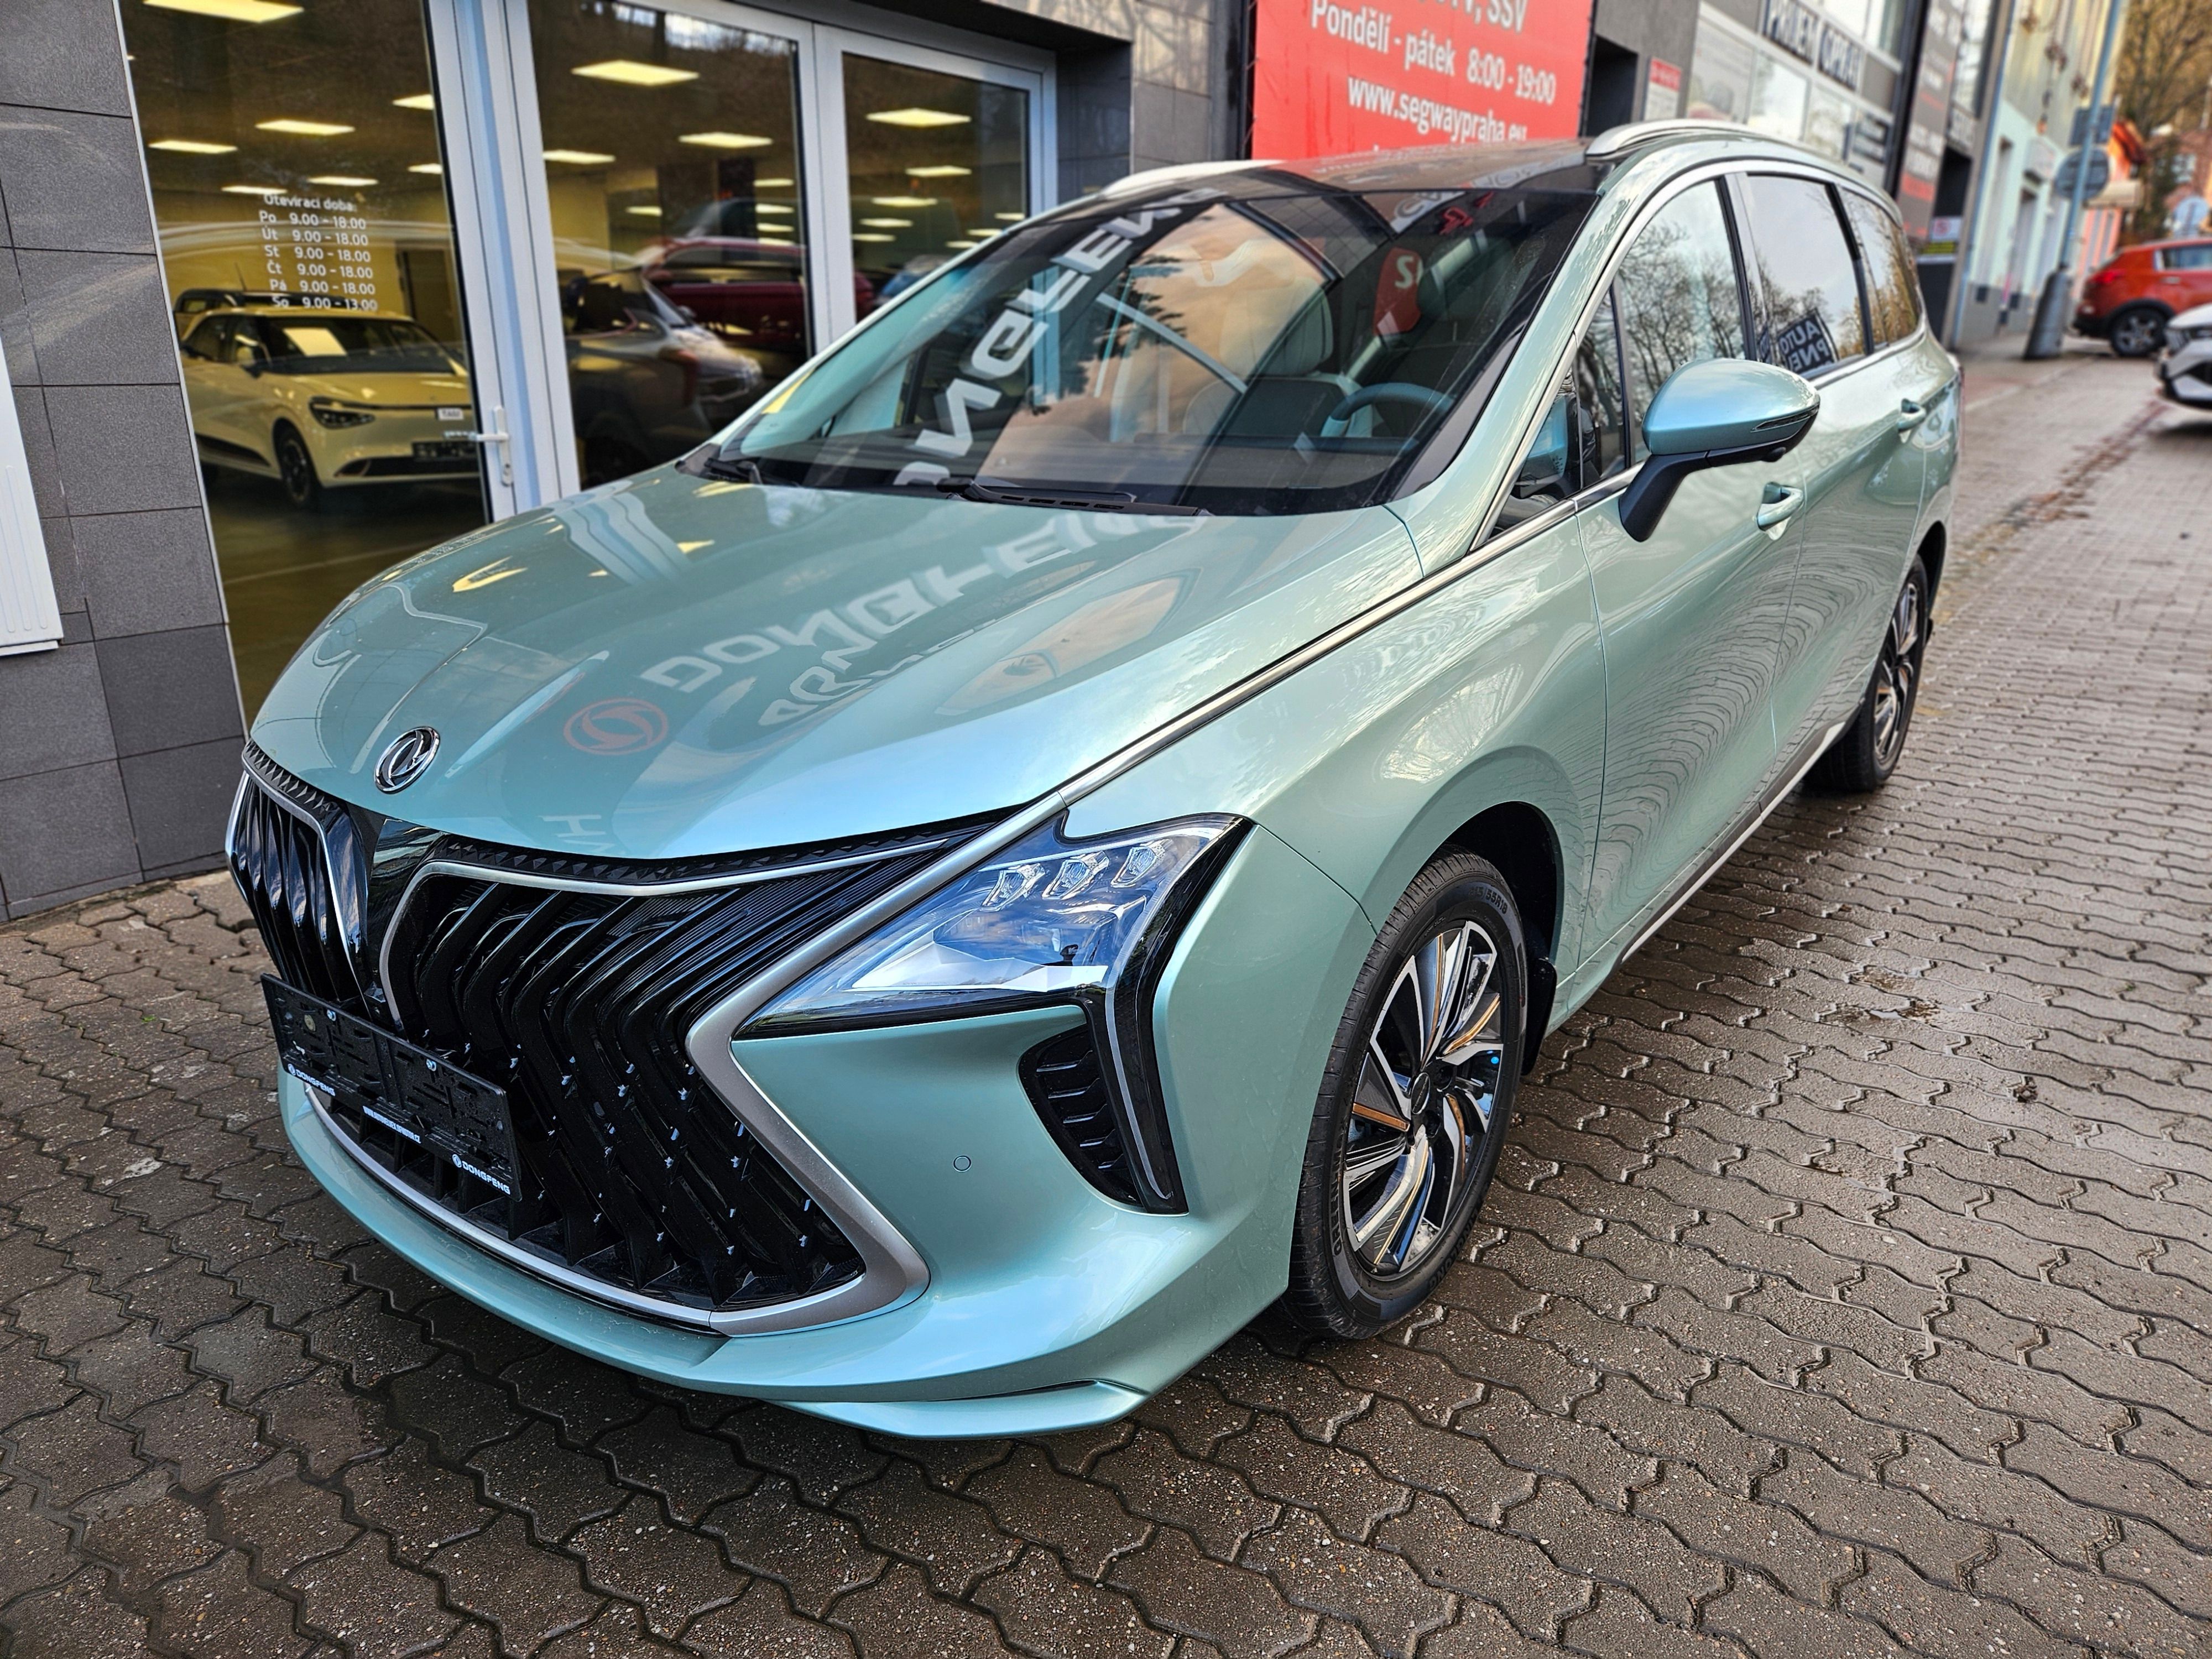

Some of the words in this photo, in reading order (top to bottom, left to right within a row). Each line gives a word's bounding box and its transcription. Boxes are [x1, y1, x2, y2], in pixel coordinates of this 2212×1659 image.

[1311, 0, 1392, 54] Pondělí
[1405, 29, 1455, 76] pátek
[1467, 47, 1505, 90] 8:00
[1515, 64, 1556, 106] 19:00
[1348, 76, 1527, 143] www.segwayprahaeu
[259, 210, 276, 222] Po
[289, 212, 319, 226] 9.00
[333, 216, 366, 230] 18.00
[262, 225, 278, 240] Út
[293, 229, 321, 242] 9.00
[335, 233, 368, 246] 18.00
[264, 245, 280, 258] St
[295, 247, 324, 259] 9.00
[337, 249, 371, 262] 18.00
[267, 260, 283, 274] Čt
[297, 263, 327, 276] 9.00
[340, 266, 373, 279] 18.00
[269, 279, 287, 291] Pá
[299, 280, 328, 293] 9.00
[342, 283, 375, 295] 18.00
[272, 296, 290, 309] So
[302, 297, 331, 309] 9.00
[345, 299, 378, 312] 13.00
[296, 1069, 336, 1097] DONGFENG
[462, 1161, 511, 1195] DONGFENG
